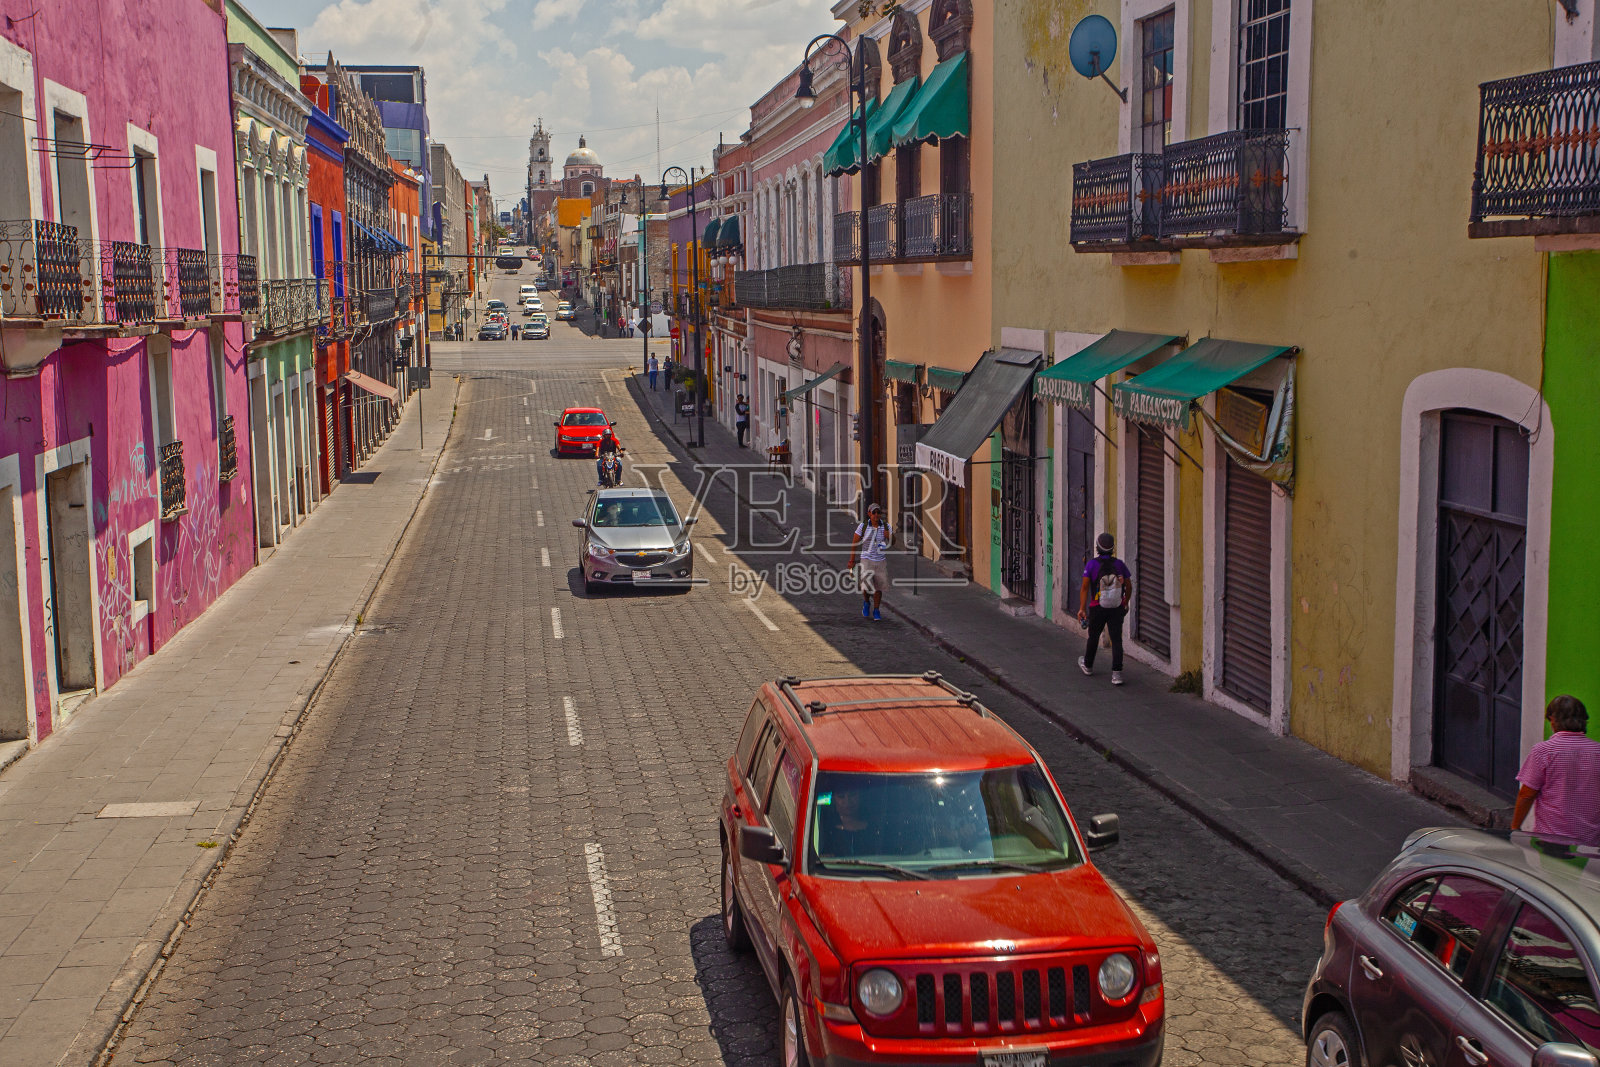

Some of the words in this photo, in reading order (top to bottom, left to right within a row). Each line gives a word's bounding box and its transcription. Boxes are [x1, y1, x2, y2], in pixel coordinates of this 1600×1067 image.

[1037, 377, 1083, 401] TAQUERIA
[1114, 388, 1124, 409] EL
[1129, 392, 1182, 420] PARIANCITO
